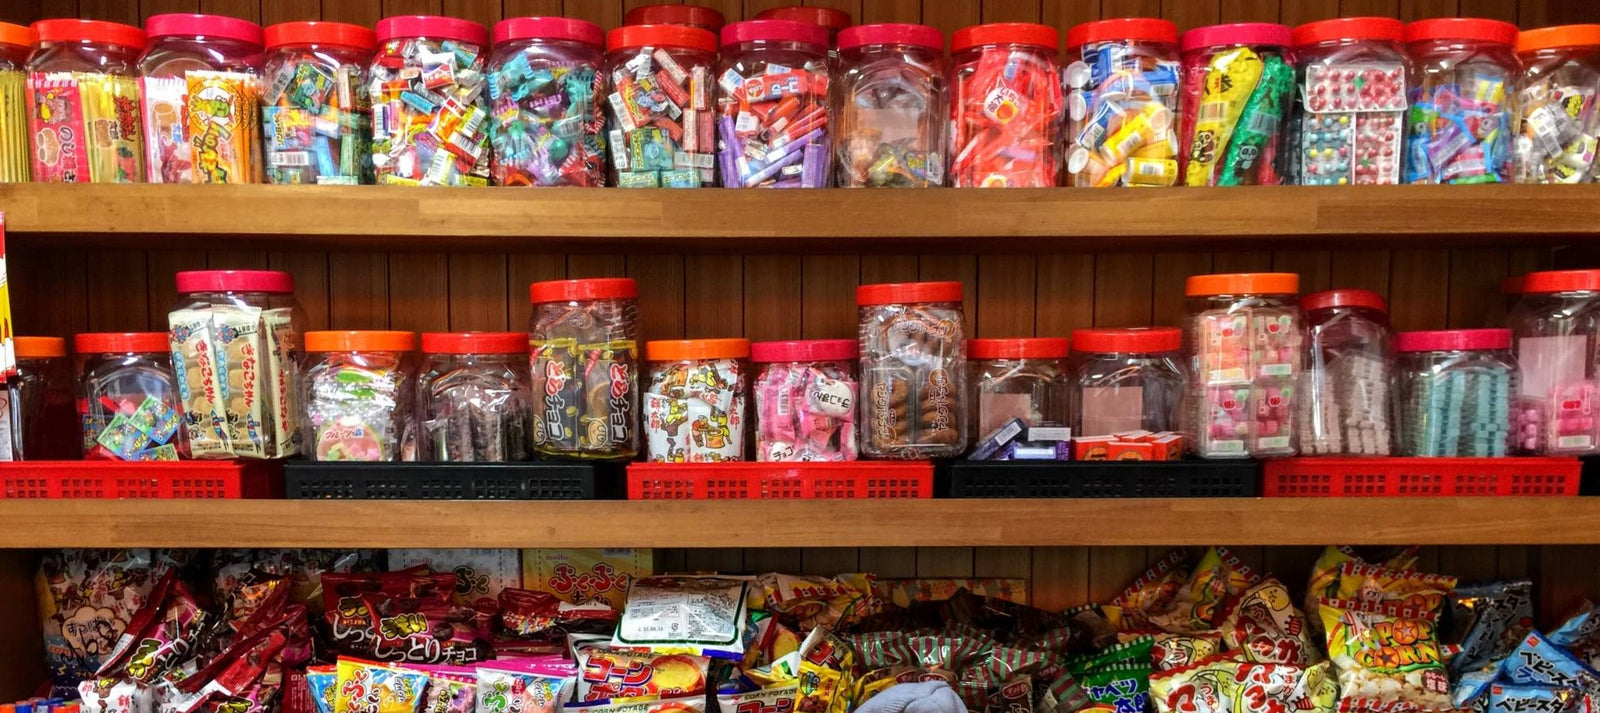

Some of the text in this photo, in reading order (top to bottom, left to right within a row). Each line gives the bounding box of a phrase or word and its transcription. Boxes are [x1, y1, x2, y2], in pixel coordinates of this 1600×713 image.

[194, 338, 218, 405] きなこちゃん
[241, 342, 256, 408] きなこちゃん
[545, 360, 566, 442] どらチョコ
[610, 363, 629, 443] どらチョコ
[812, 389, 851, 409] チョコまん
[549, 563, 628, 595] ぷくぷく
[381, 612, 429, 639] うまい
[375, 633, 477, 664] しっとりチョコ
[623, 650, 654, 659] POTAGE
[1354, 645, 1441, 668] CORN
[583, 655, 654, 686] コーン
[769, 688, 797, 697] POTAG
[1089, 677, 1138, 701] ャベツ
[616, 703, 650, 713] POTAGE
